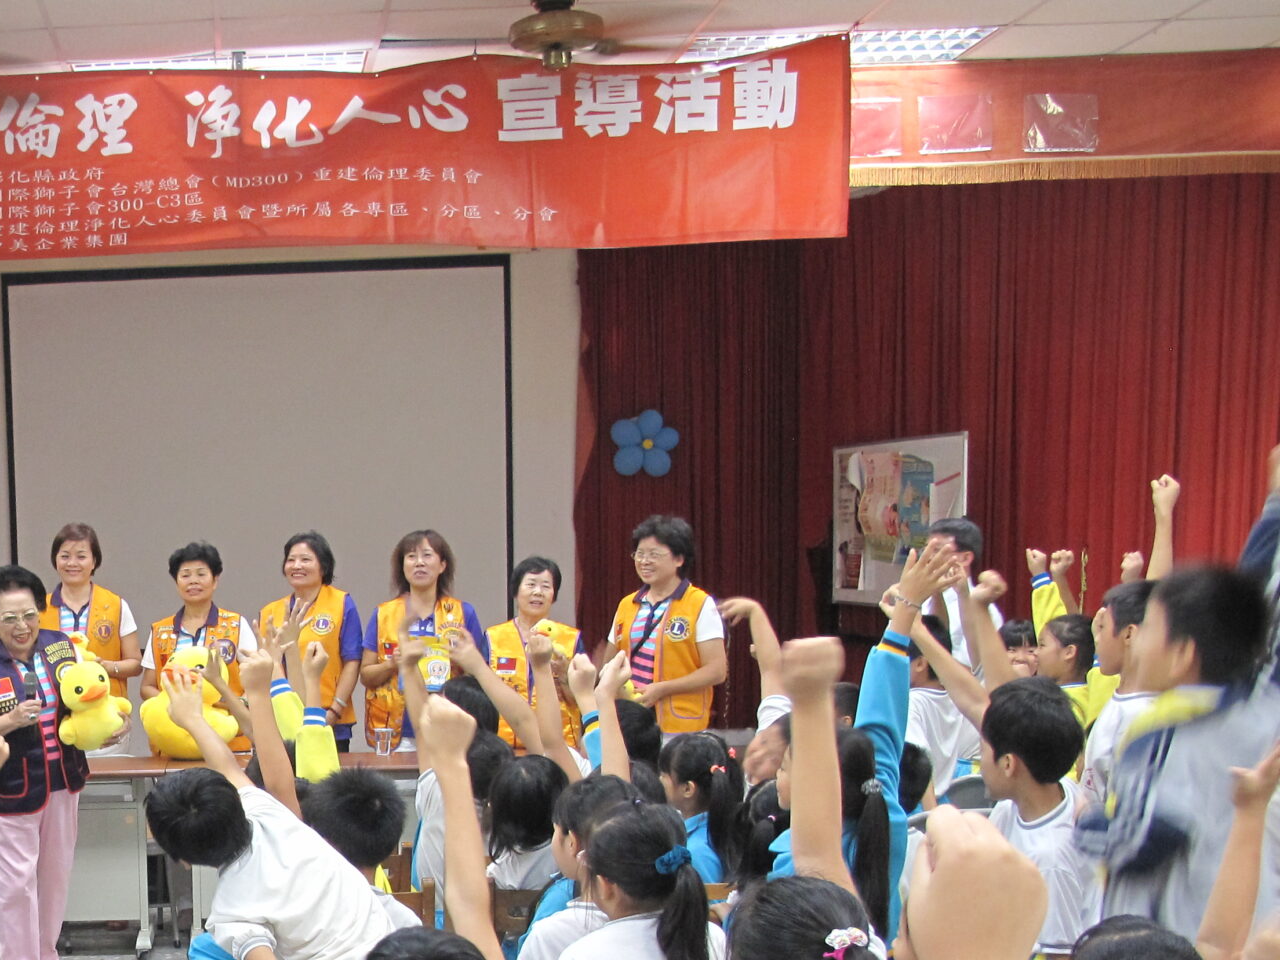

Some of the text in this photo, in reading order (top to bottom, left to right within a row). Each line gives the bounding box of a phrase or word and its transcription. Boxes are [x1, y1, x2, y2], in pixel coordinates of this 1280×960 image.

[184, 83, 470, 159] 淨化人心
[497, 58, 799, 142] 宣導活動
